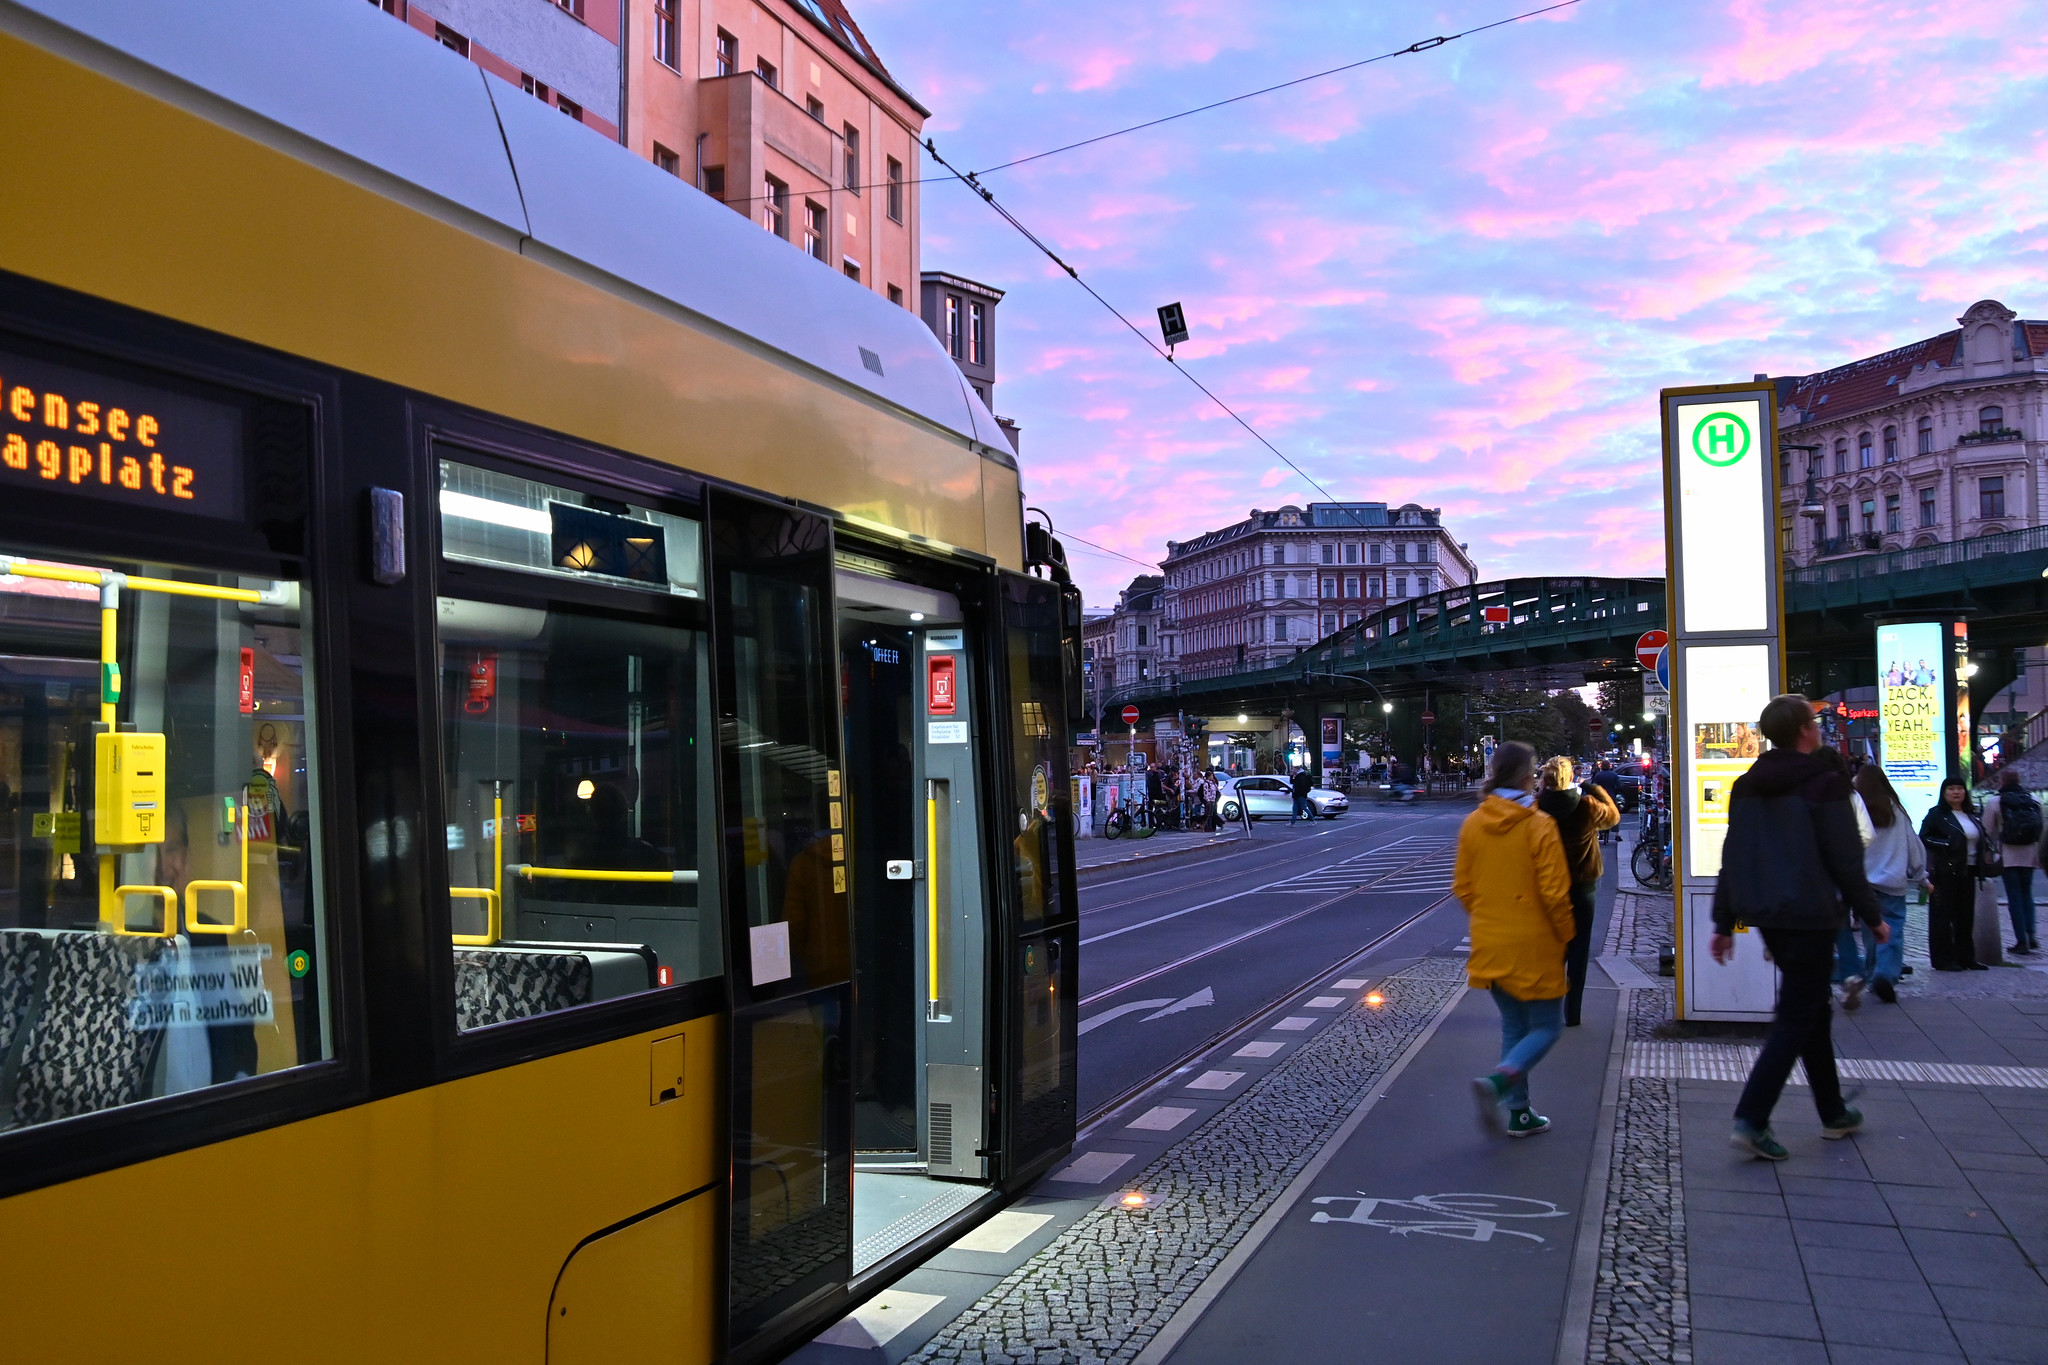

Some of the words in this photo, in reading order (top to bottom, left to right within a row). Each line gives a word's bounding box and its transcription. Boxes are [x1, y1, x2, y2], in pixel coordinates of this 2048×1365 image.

[1161, 306, 1183, 333] H
[0, 379, 159, 448] ensee
[1707, 423, 1735, 455] H
[2, 433, 194, 499] agplatz
[873, 647, 892, 664] OFFEE
[1889, 687, 1934, 701] ZACK.
[1848, 708, 1879, 720] Sparkass
[1883, 703, 1937, 717] BOOM.
[1888, 719, 1930, 732] YEAH.
[1912, 733, 1938, 742] GEHT
